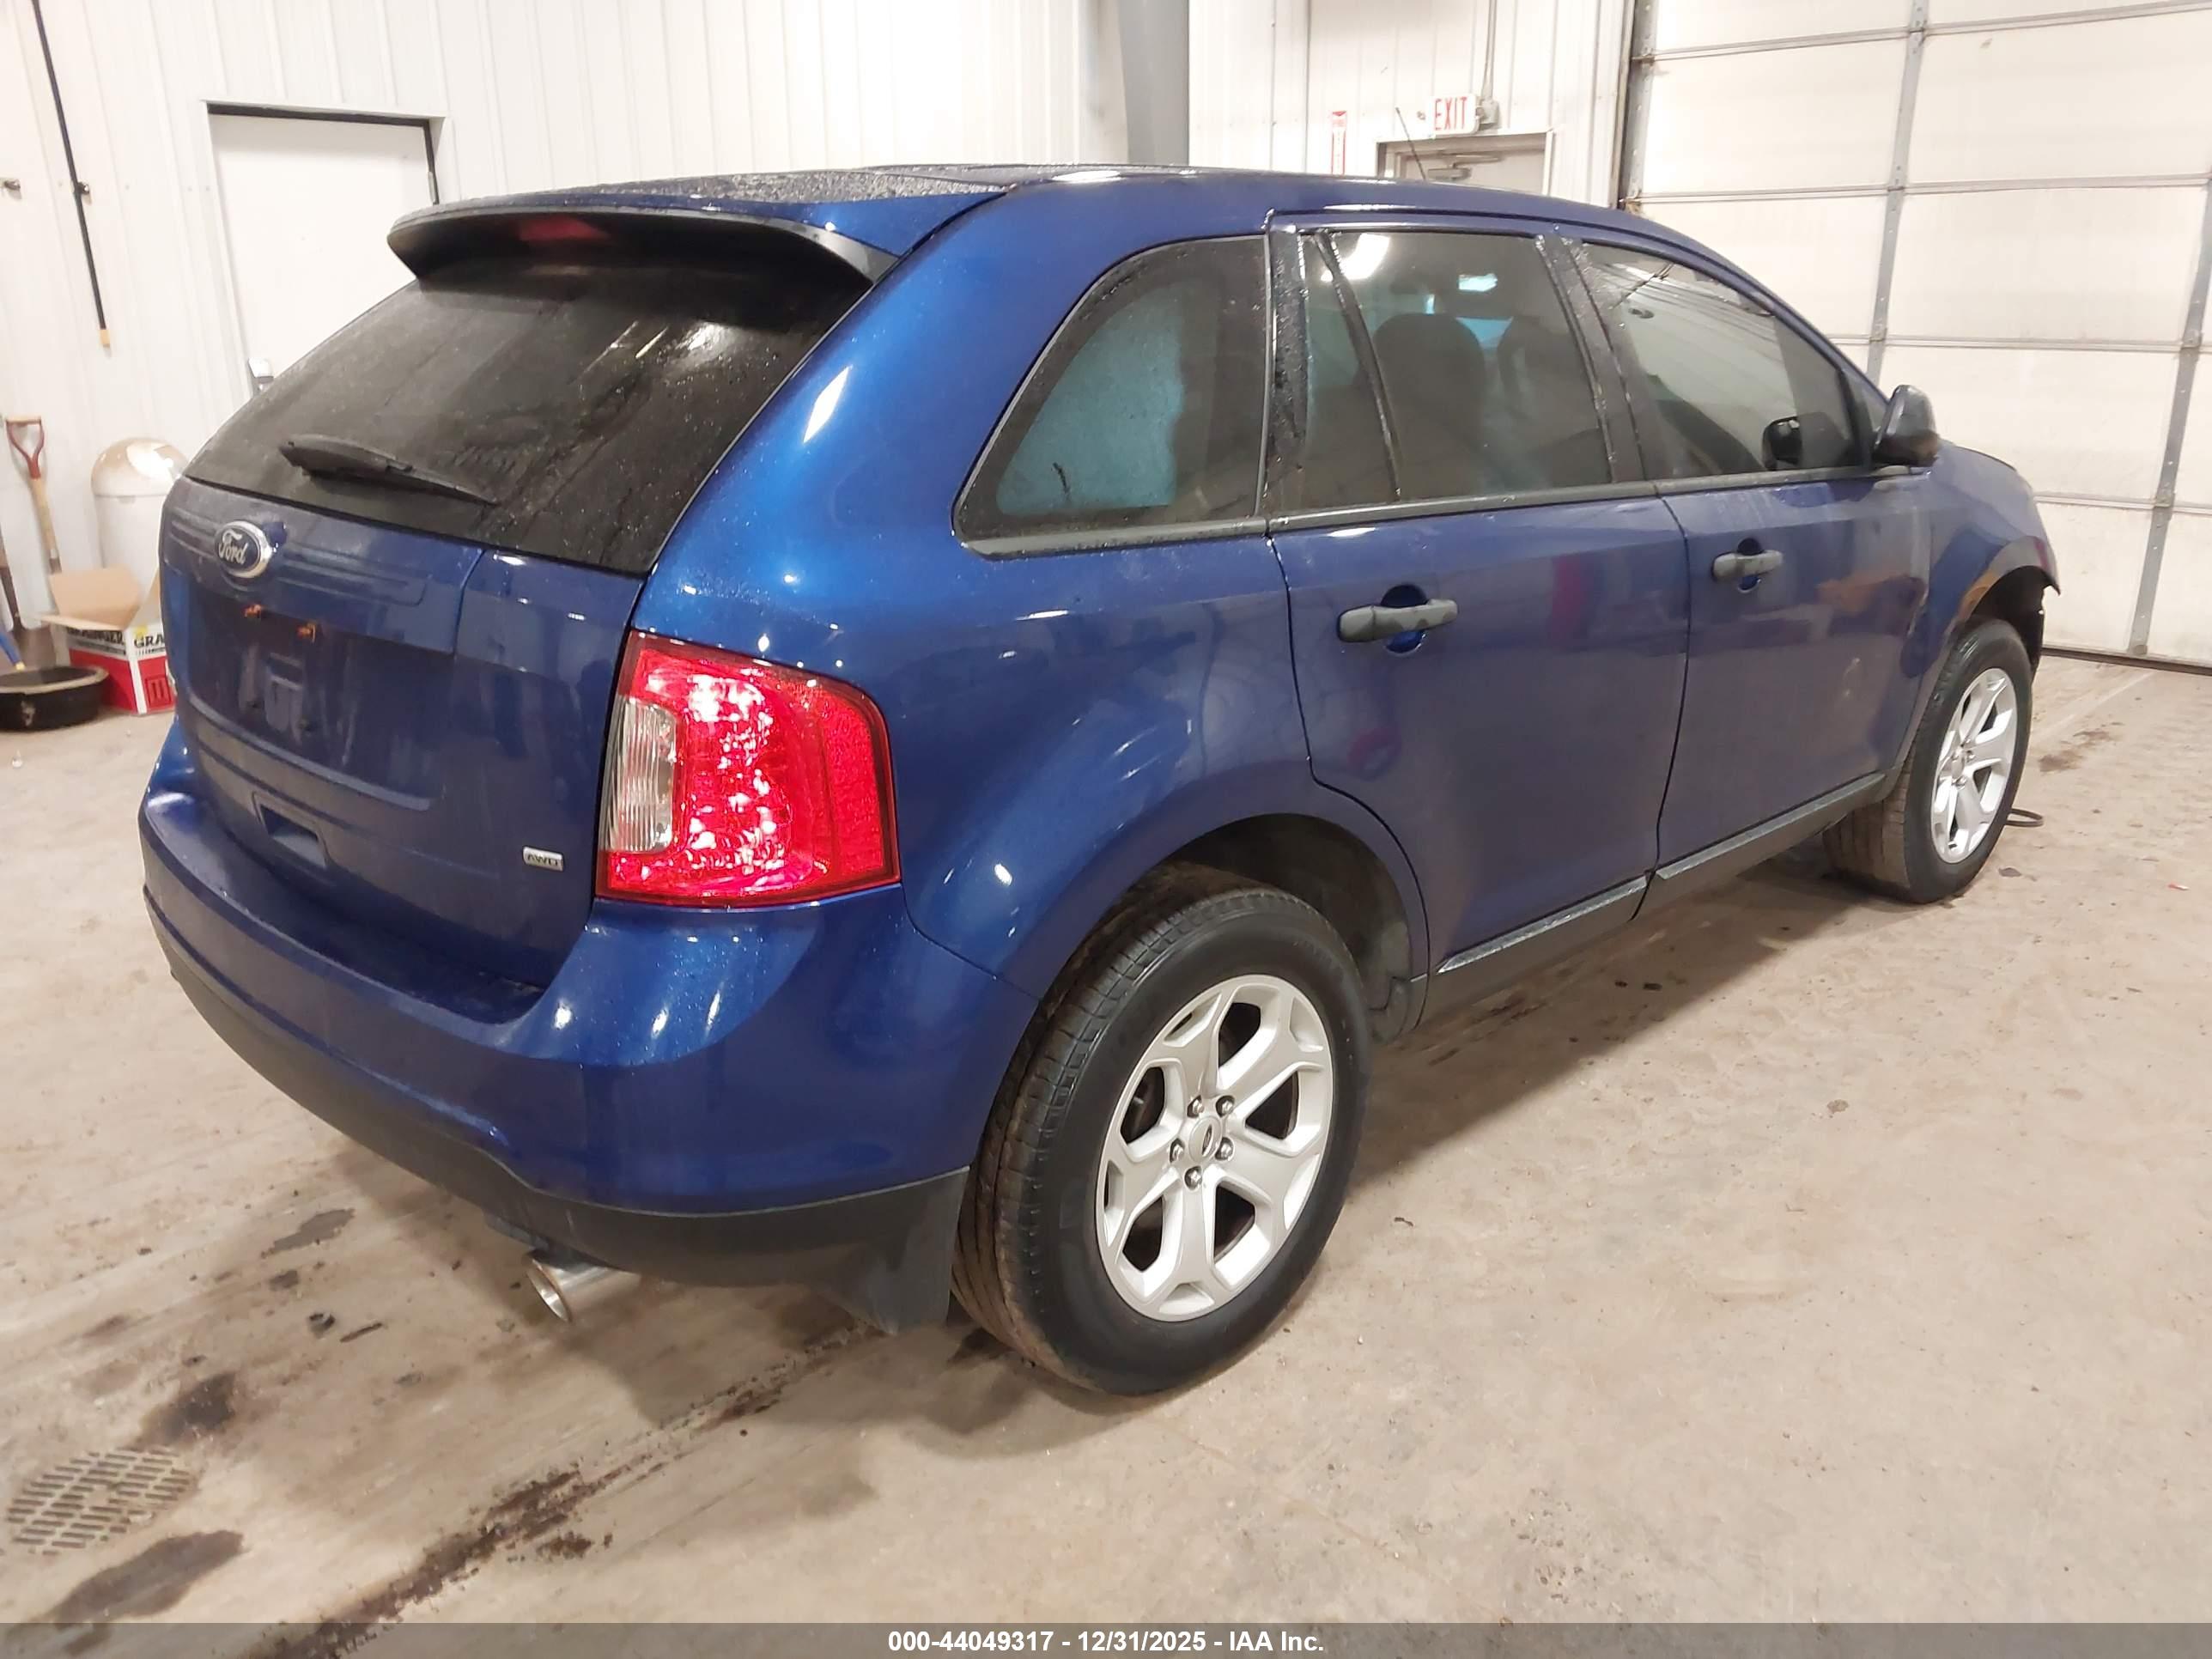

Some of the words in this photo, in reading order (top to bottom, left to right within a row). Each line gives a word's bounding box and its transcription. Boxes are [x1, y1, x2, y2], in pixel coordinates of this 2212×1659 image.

[1434, 96, 1468, 131] EXIT
[218, 528, 250, 565] Ford
[526, 854, 559, 866] AWD
